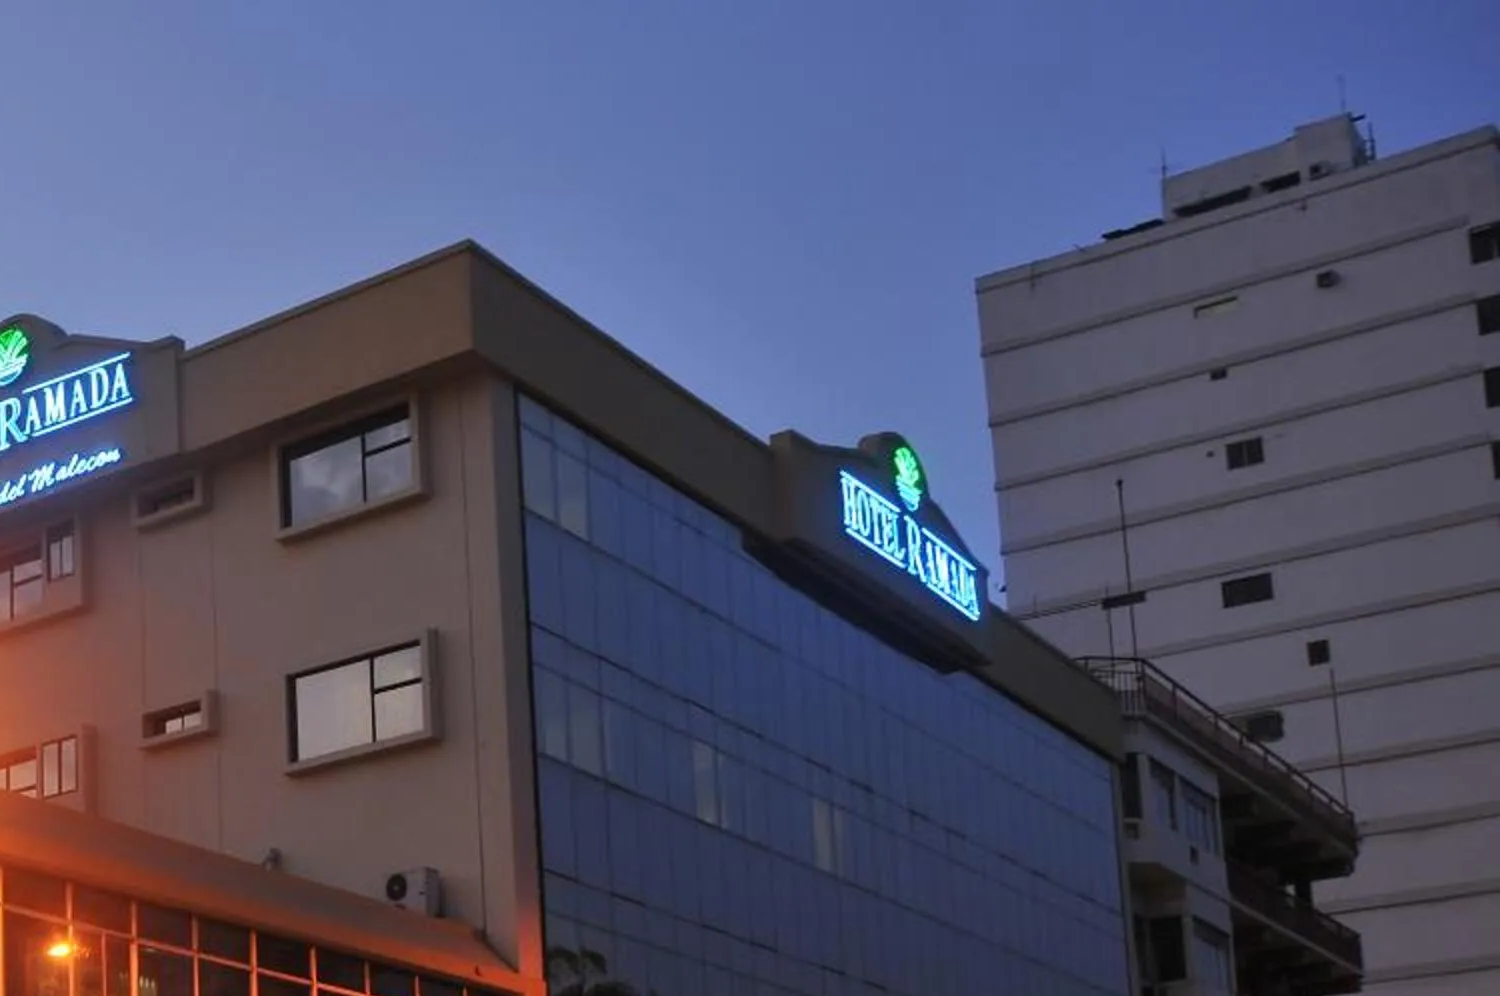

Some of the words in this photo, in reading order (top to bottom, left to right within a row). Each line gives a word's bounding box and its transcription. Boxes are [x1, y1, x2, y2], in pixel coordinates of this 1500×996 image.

[27, 449, 121, 492] Malecon
[841, 477, 905, 560] HOTEL
[904, 515, 981, 616] RAMADA
